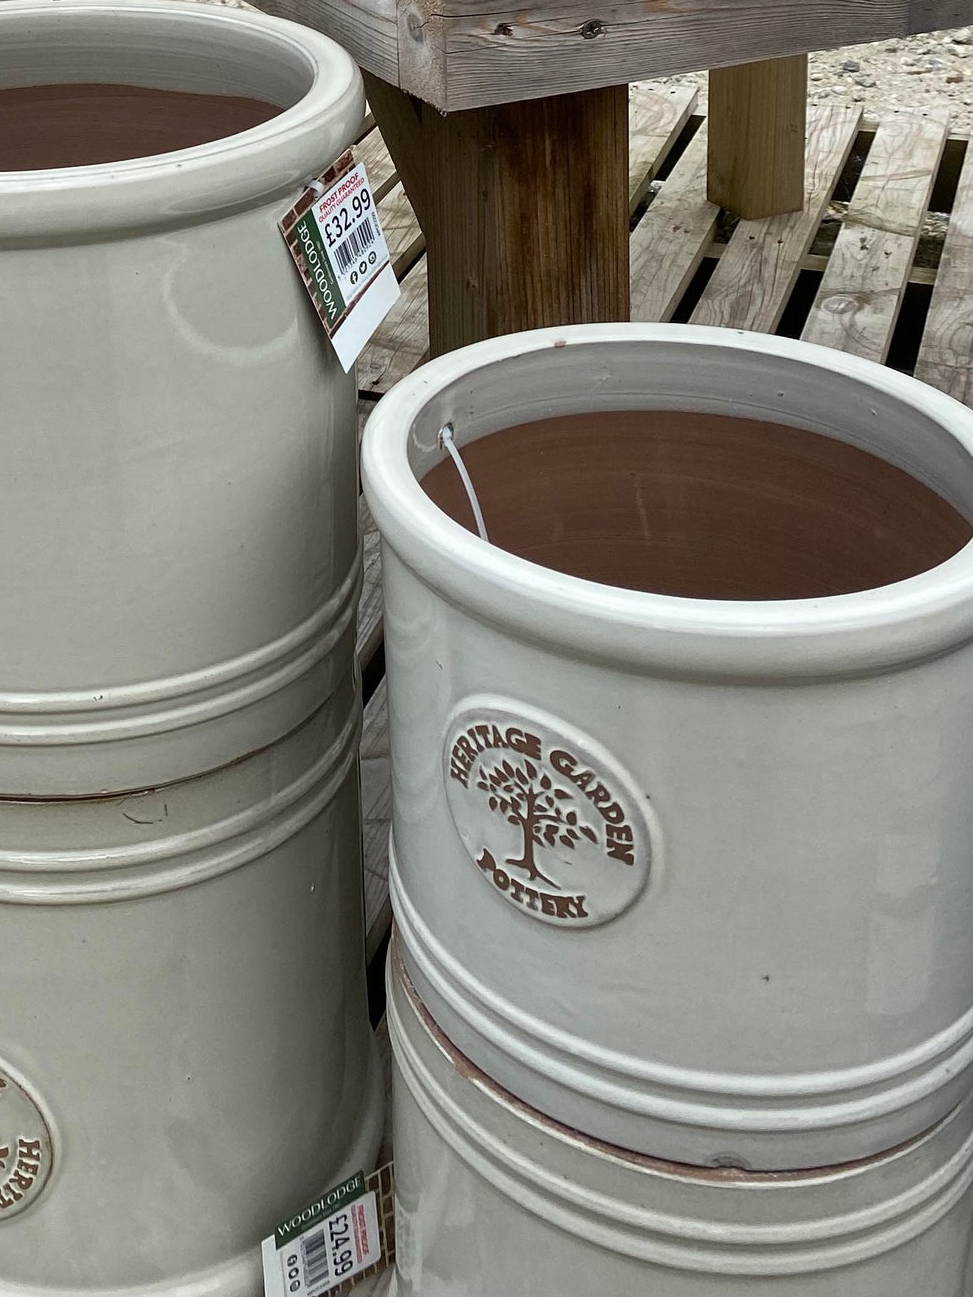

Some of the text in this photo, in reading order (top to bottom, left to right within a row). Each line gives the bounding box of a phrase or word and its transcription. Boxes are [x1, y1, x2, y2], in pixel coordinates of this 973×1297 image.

[319, 172, 359, 213] FROST PROOF
[325, 188, 371, 248] £32.99
[297, 220, 337, 320] WOODLODGE
[450, 724, 635, 866] HERITAGE GARDEN
[328, 1214, 354, 1277] £24.99
